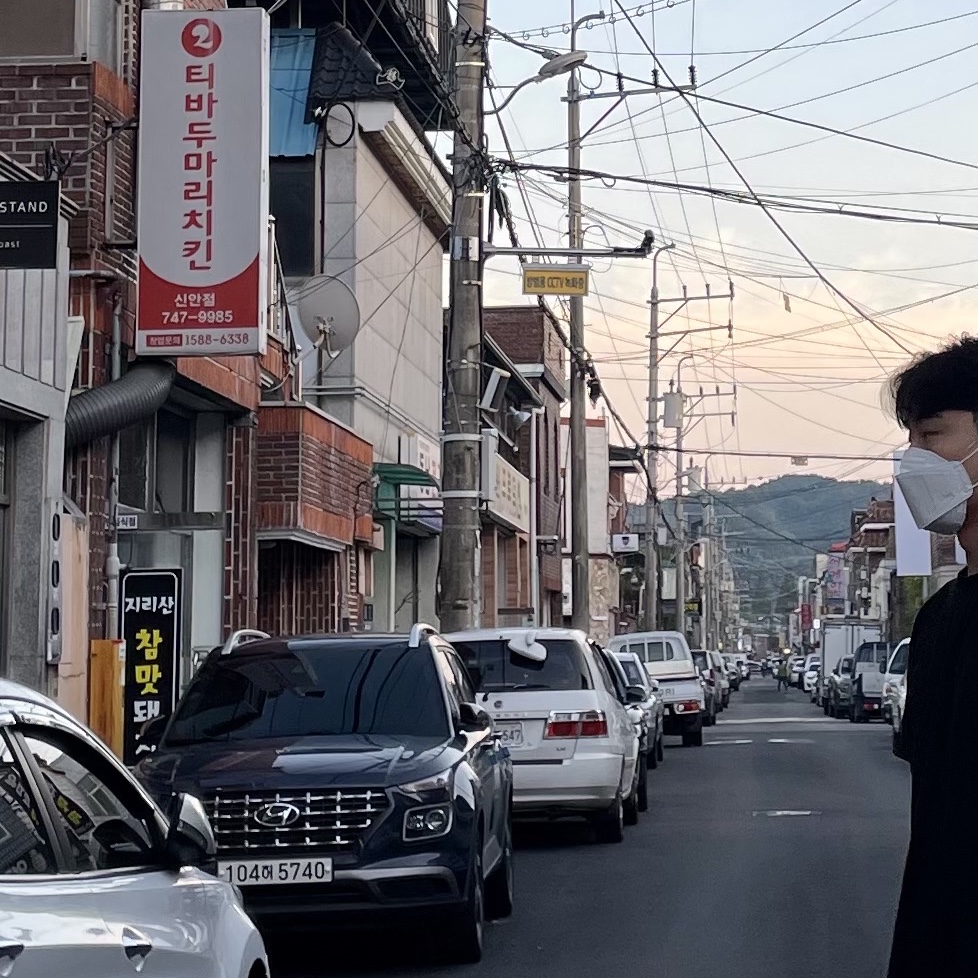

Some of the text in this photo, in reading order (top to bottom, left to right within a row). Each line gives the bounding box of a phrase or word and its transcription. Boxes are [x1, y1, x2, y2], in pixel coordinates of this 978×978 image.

[182, 63, 218, 271] 티바두마리치킨
[0, 201, 48, 213] STAND
[174, 293, 215, 307] 신안점
[162, 310, 233, 324] 747-9985
[185, 333, 249, 346] 1588-6338
[125, 596, 174, 615] 지리산
[278, 861, 325, 881] 5740
